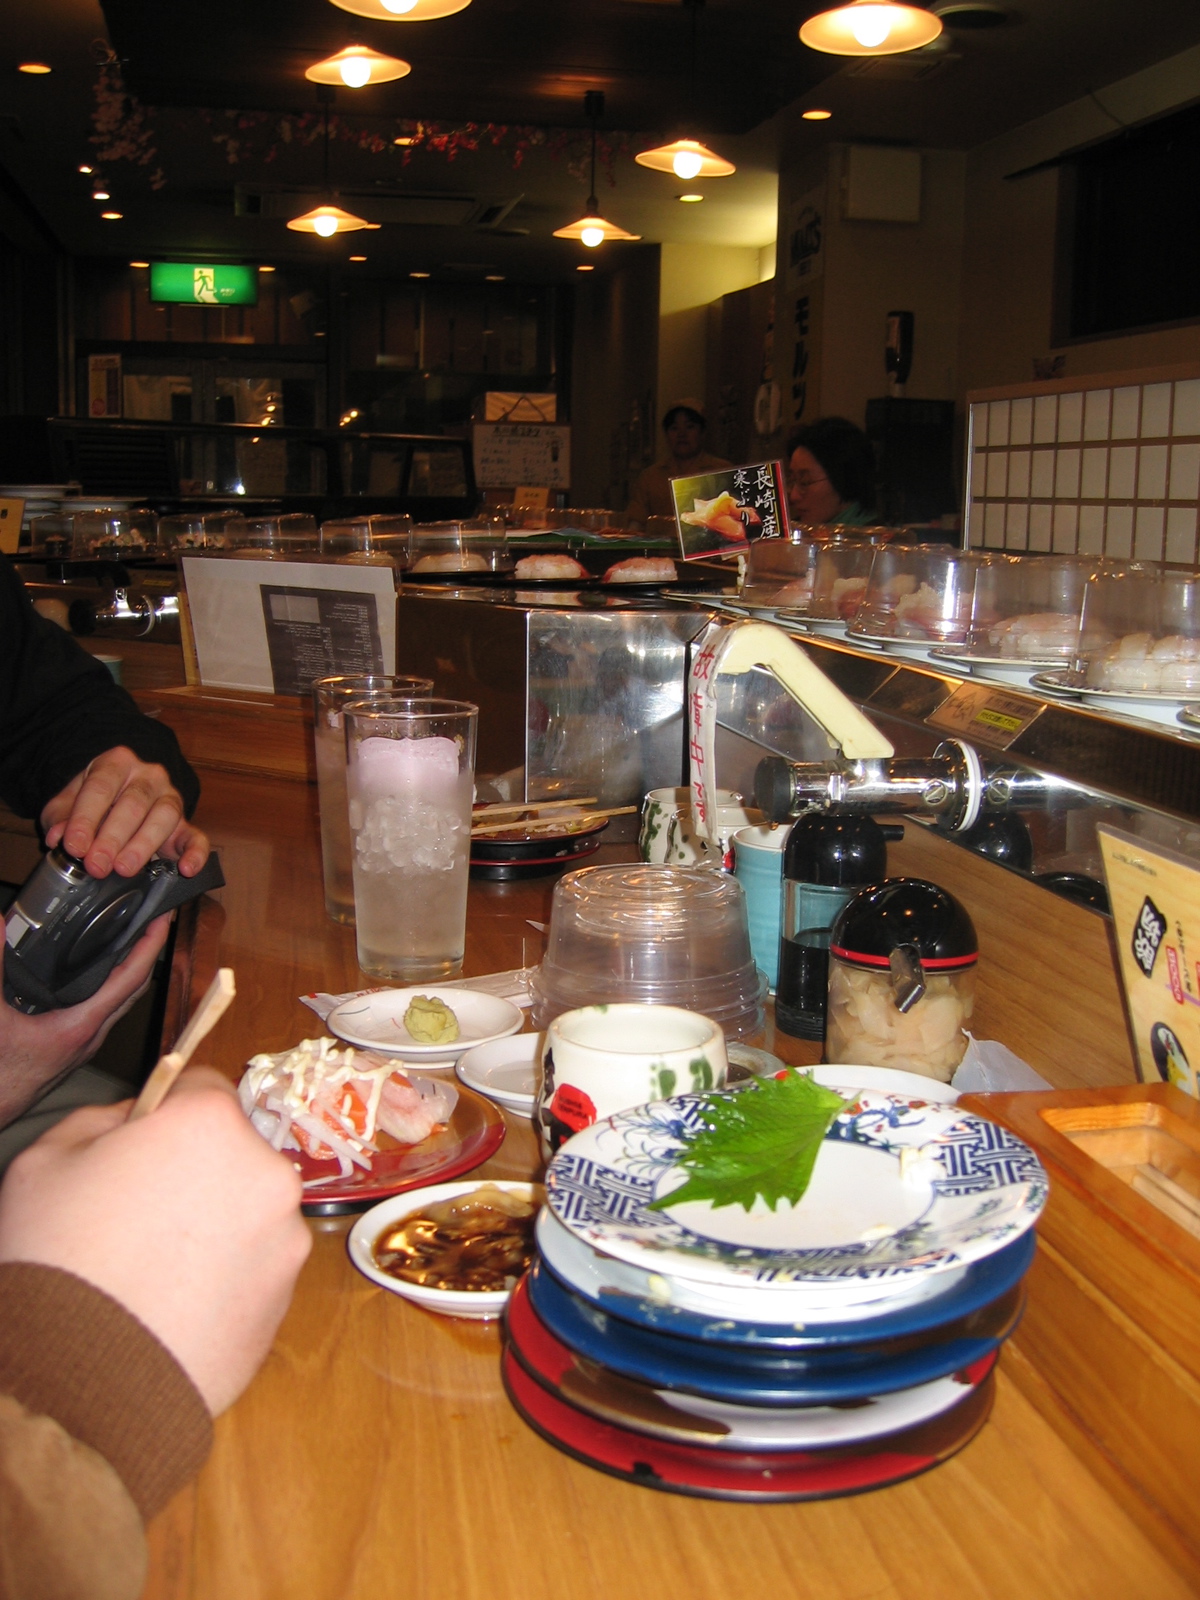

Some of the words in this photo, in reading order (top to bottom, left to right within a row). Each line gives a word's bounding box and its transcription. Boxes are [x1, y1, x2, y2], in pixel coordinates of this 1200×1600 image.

[733, 469, 751, 526] 寒ぶり
[752, 465, 780, 539] 長崎産
